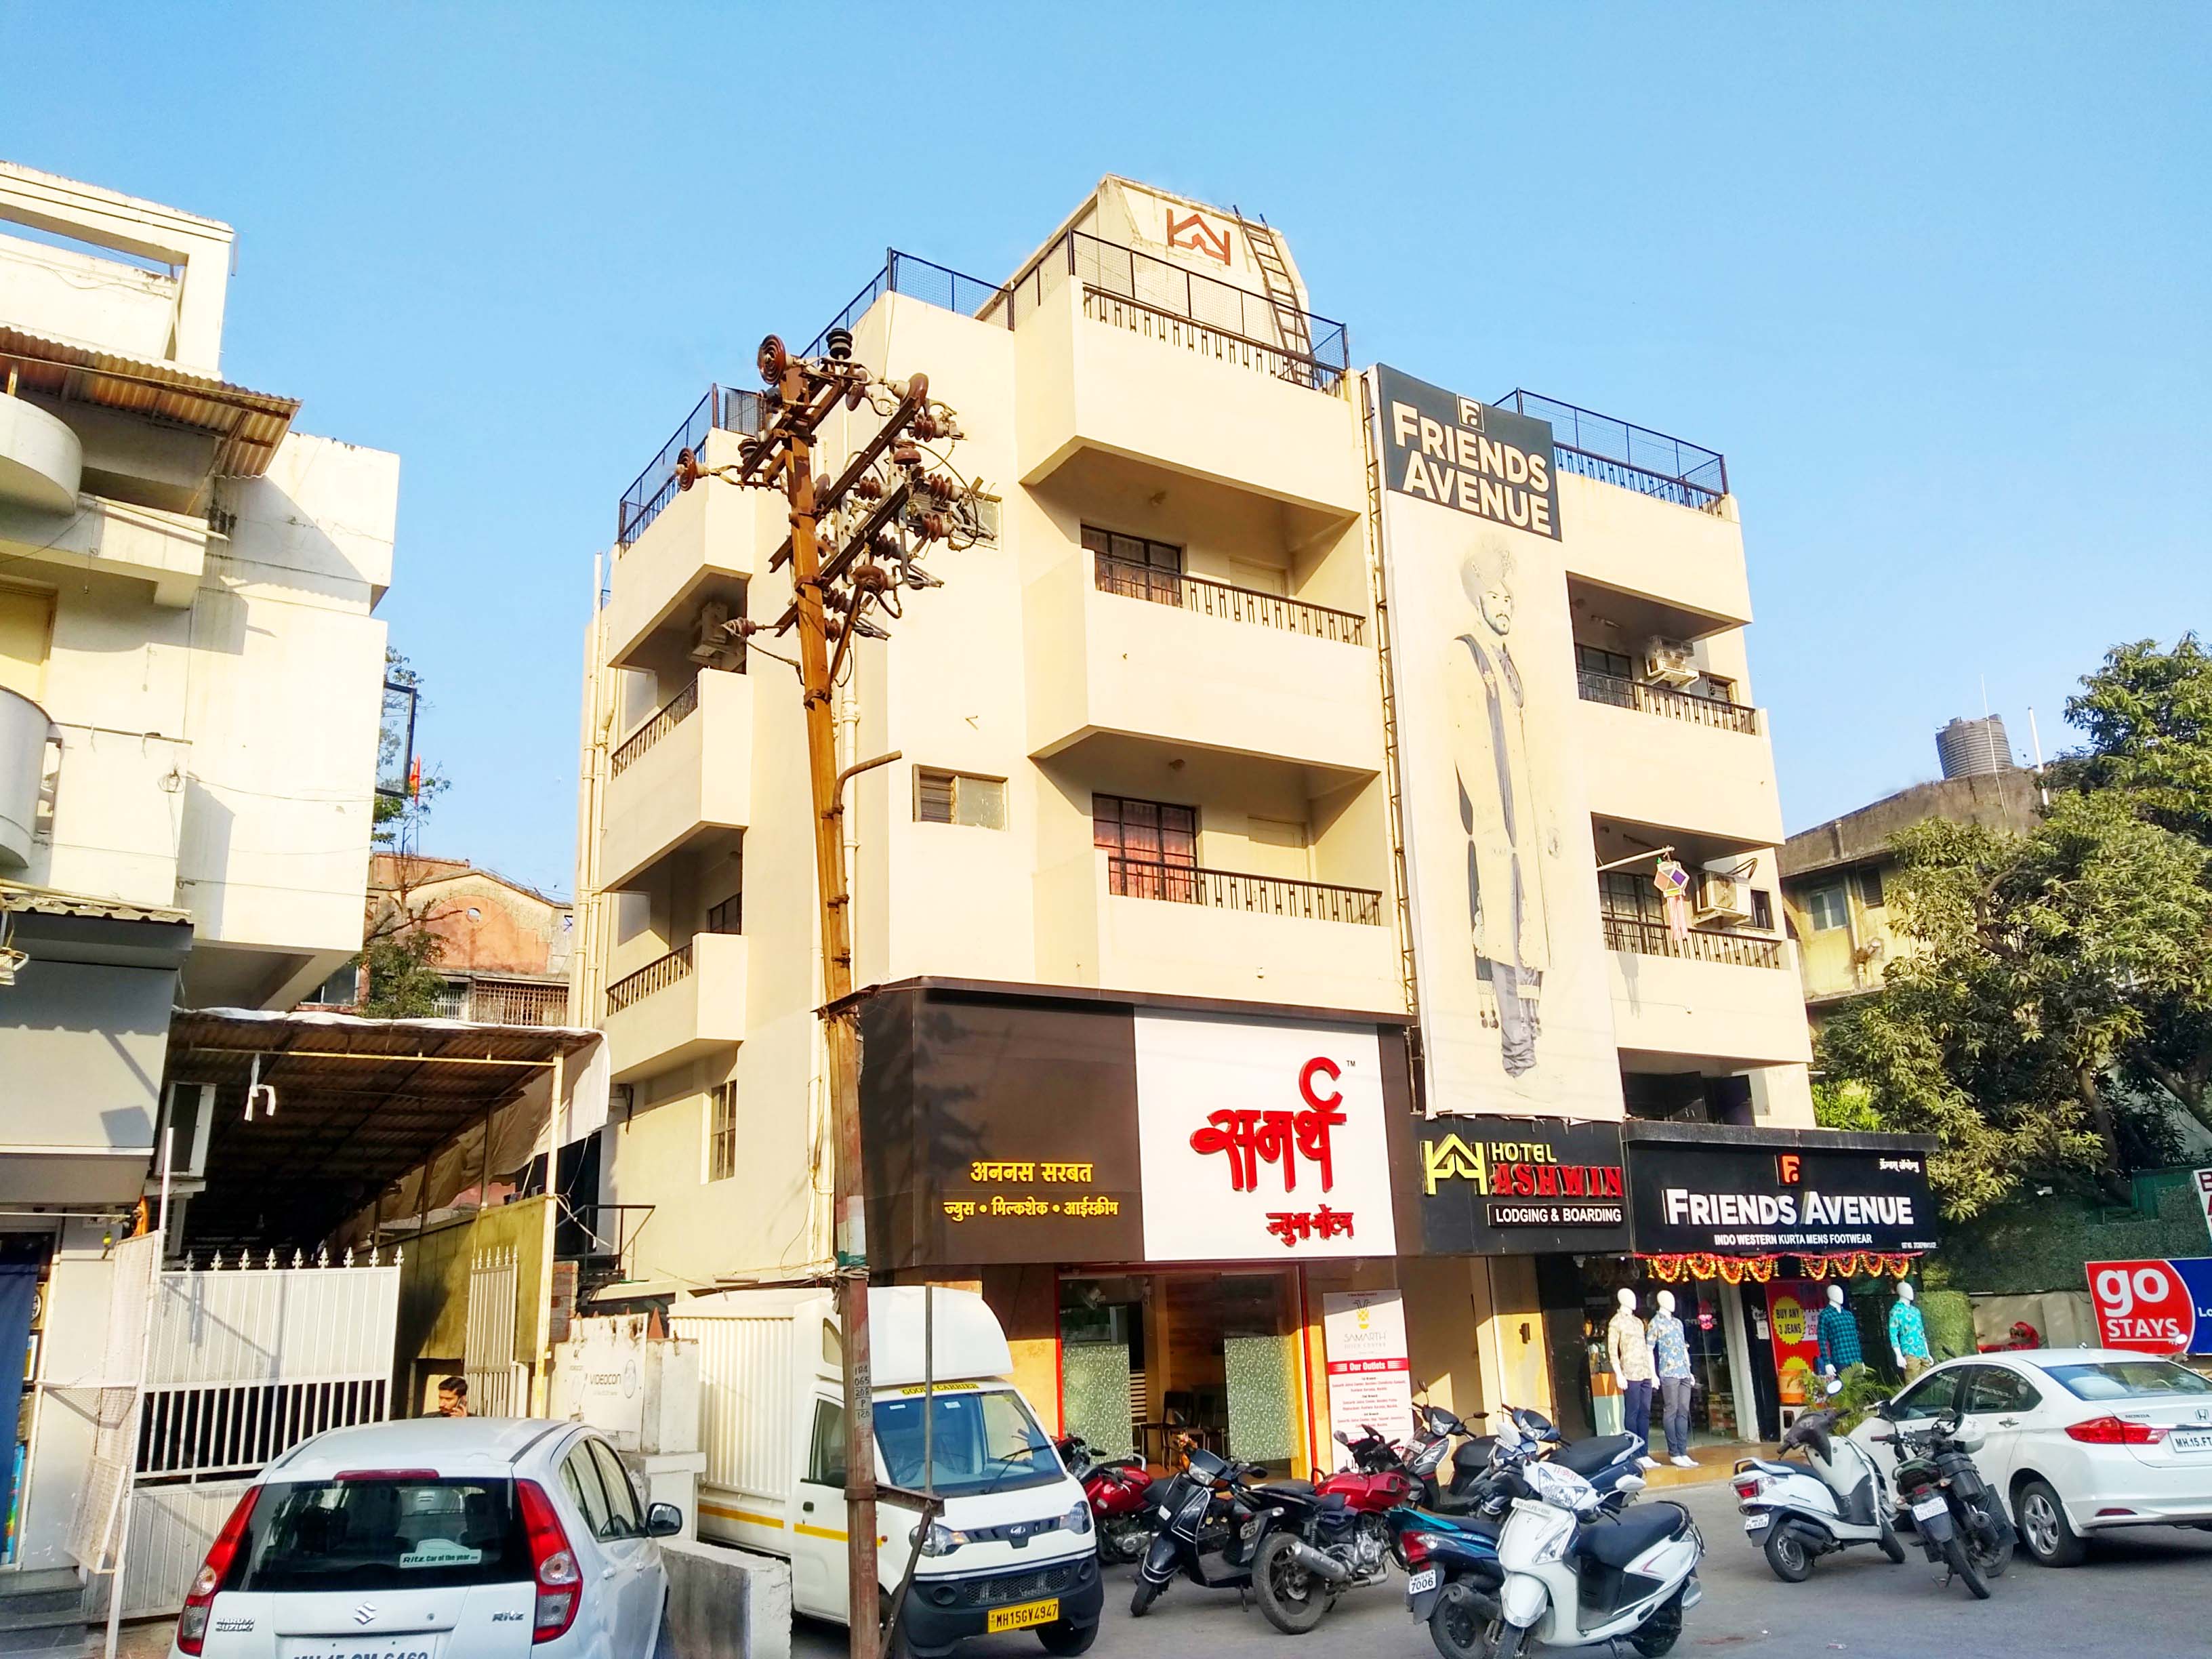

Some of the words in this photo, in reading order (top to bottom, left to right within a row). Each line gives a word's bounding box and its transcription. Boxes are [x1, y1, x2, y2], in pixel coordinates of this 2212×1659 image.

[1393, 401, 1549, 492] FRIENDS
[1403, 450, 1552, 535] AVENUE
[1190, 1057, 1347, 1193] समर्थ
[1491, 1142, 1557, 1162] HOTEL
[970, 1162, 1035, 1182] अननस
[1040, 1162, 1092, 1182] सरबत
[1490, 1163, 1623, 1197] ASHWIN
[943, 1202, 975, 1221] ज्युस
[991, 1196, 1048, 1215] मिल्कशेक
[1496, 1208, 1549, 1223] LODGING
[1551, 1208, 1559, 1222] &
[1563, 1208, 1621, 1222] BOARDING
[1664, 1189, 1797, 1225] FRIENDS
[1801, 1191, 1914, 1225] AVENUE
[1714, 1234, 1736, 1245] INDO
[1736, 1234, 1777, 1245] WESTERN
[1778, 1234, 1805, 1244] KURTA
[1806, 1234, 1828, 1244] MENS
[1830, 1234, 1872, 1244] FOOTWEAR
[2097, 1268, 2169, 1317] go
[1776, 1309, 1787, 1319] BUY
[1789, 1308, 1799, 1318] ANY
[1344, 1332, 1386, 1343] SAMARTH
[1778, 1324, 1782, 1334] 3
[1784, 1323, 1801, 1334] JEANS
[2106, 1318, 2180, 1338] STAYS
[1349, 1362, 1361, 1371] Our
[1363, 1361, 1386, 1370] Outlets
[861, 1399, 866, 1408] P
[1411, 1577, 1433, 1592] 7006
[492, 1611, 525, 1622] Ritz
[996, 1603, 1058, 1628] MH15GV4947
